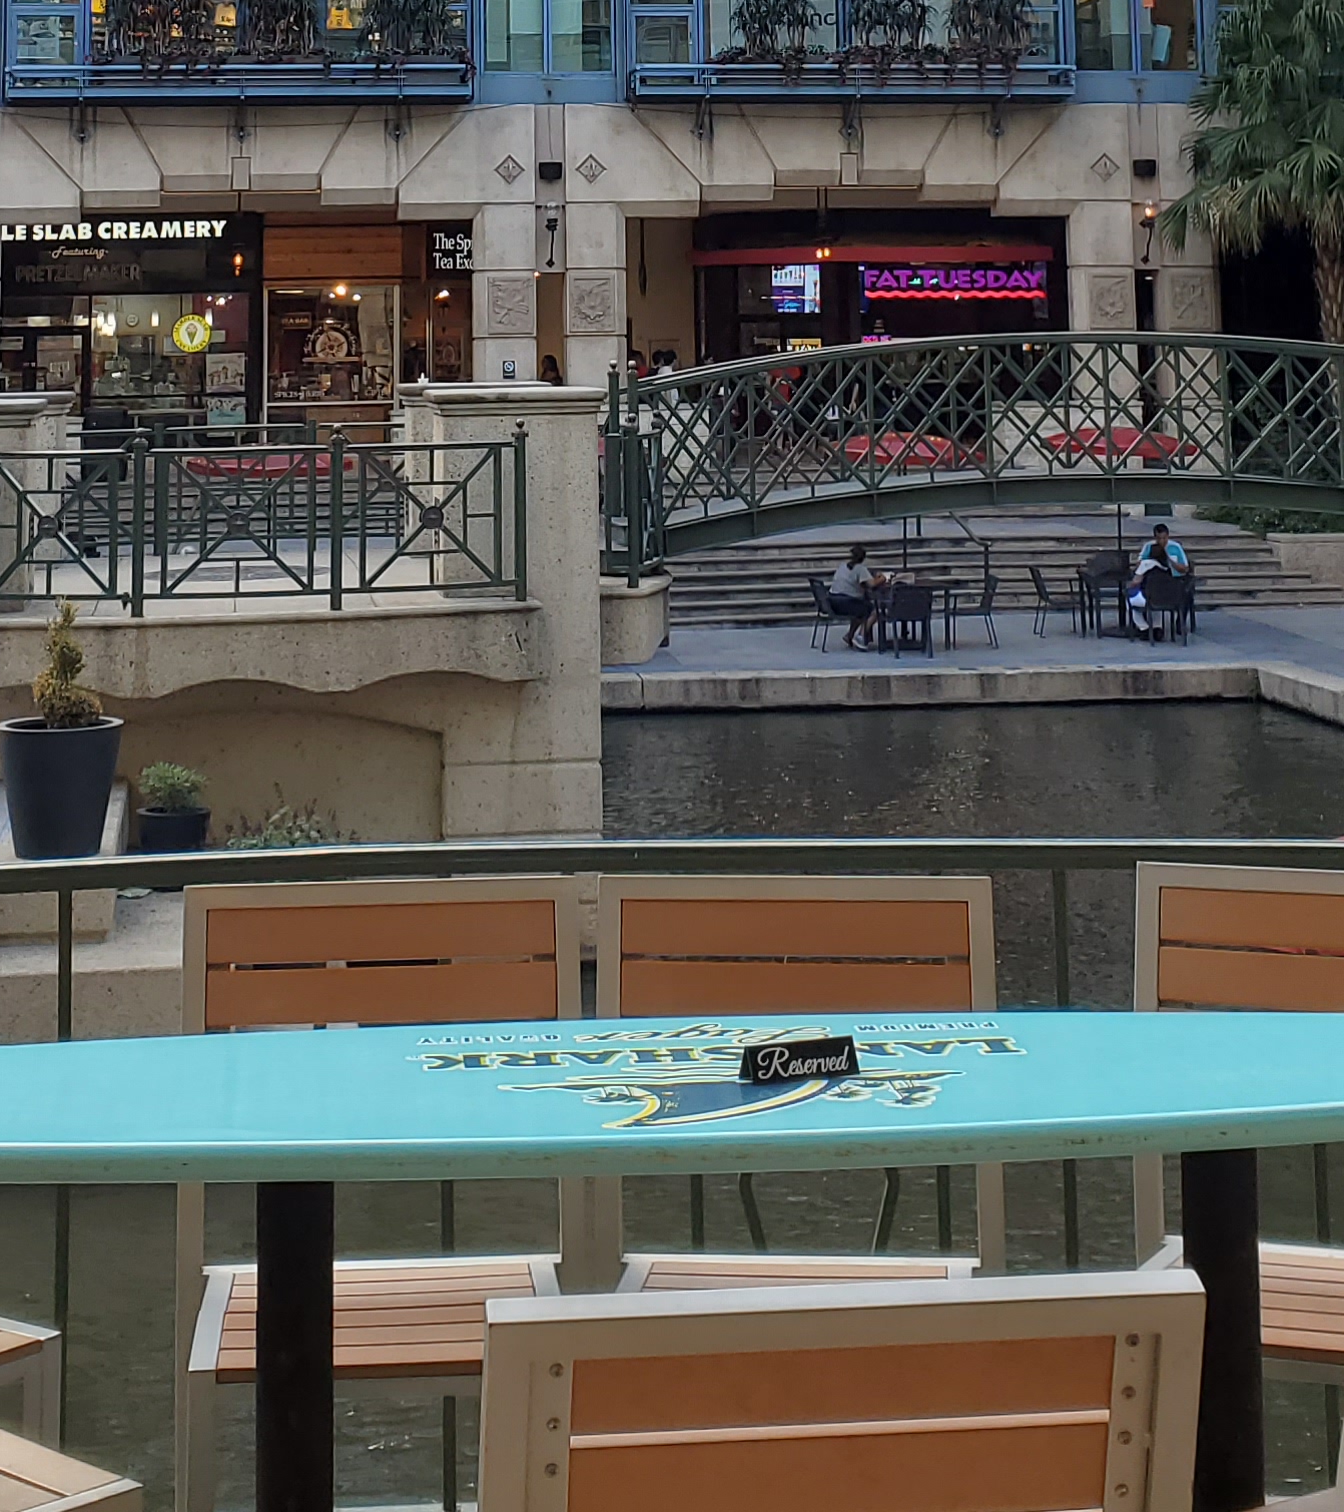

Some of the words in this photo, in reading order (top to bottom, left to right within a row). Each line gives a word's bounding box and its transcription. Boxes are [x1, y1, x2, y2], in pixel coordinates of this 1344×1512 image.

[32, 222, 94, 241] SLAB
[97, 220, 228, 239] CREAMERY
[432, 232, 455, 250] The
[432, 252, 454, 270] Tea
[865, 269, 913, 289] FAT
[916, 269, 1045, 289] TUESDAY
[855, 1021, 999, 1034] PREMIUM
[416, 1034, 562, 1046] QUALITY
[757, 1045, 850, 1080] Reserved
